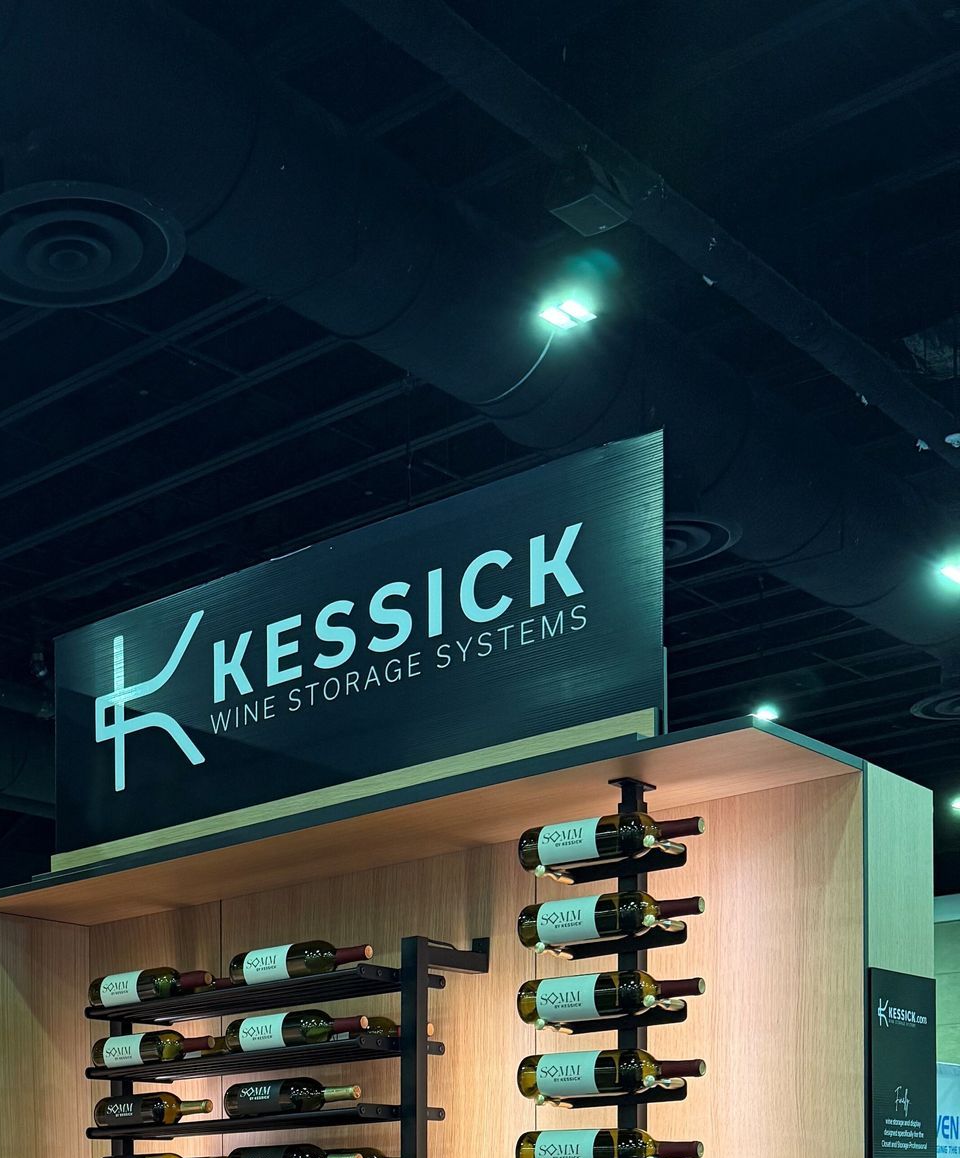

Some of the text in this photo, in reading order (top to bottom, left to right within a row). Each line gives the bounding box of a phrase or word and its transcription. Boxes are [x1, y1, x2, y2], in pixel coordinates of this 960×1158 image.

[210, 604, 588, 734] WINE STORAGE SYSTEMS
[214, 522, 583, 704] KESSICK
